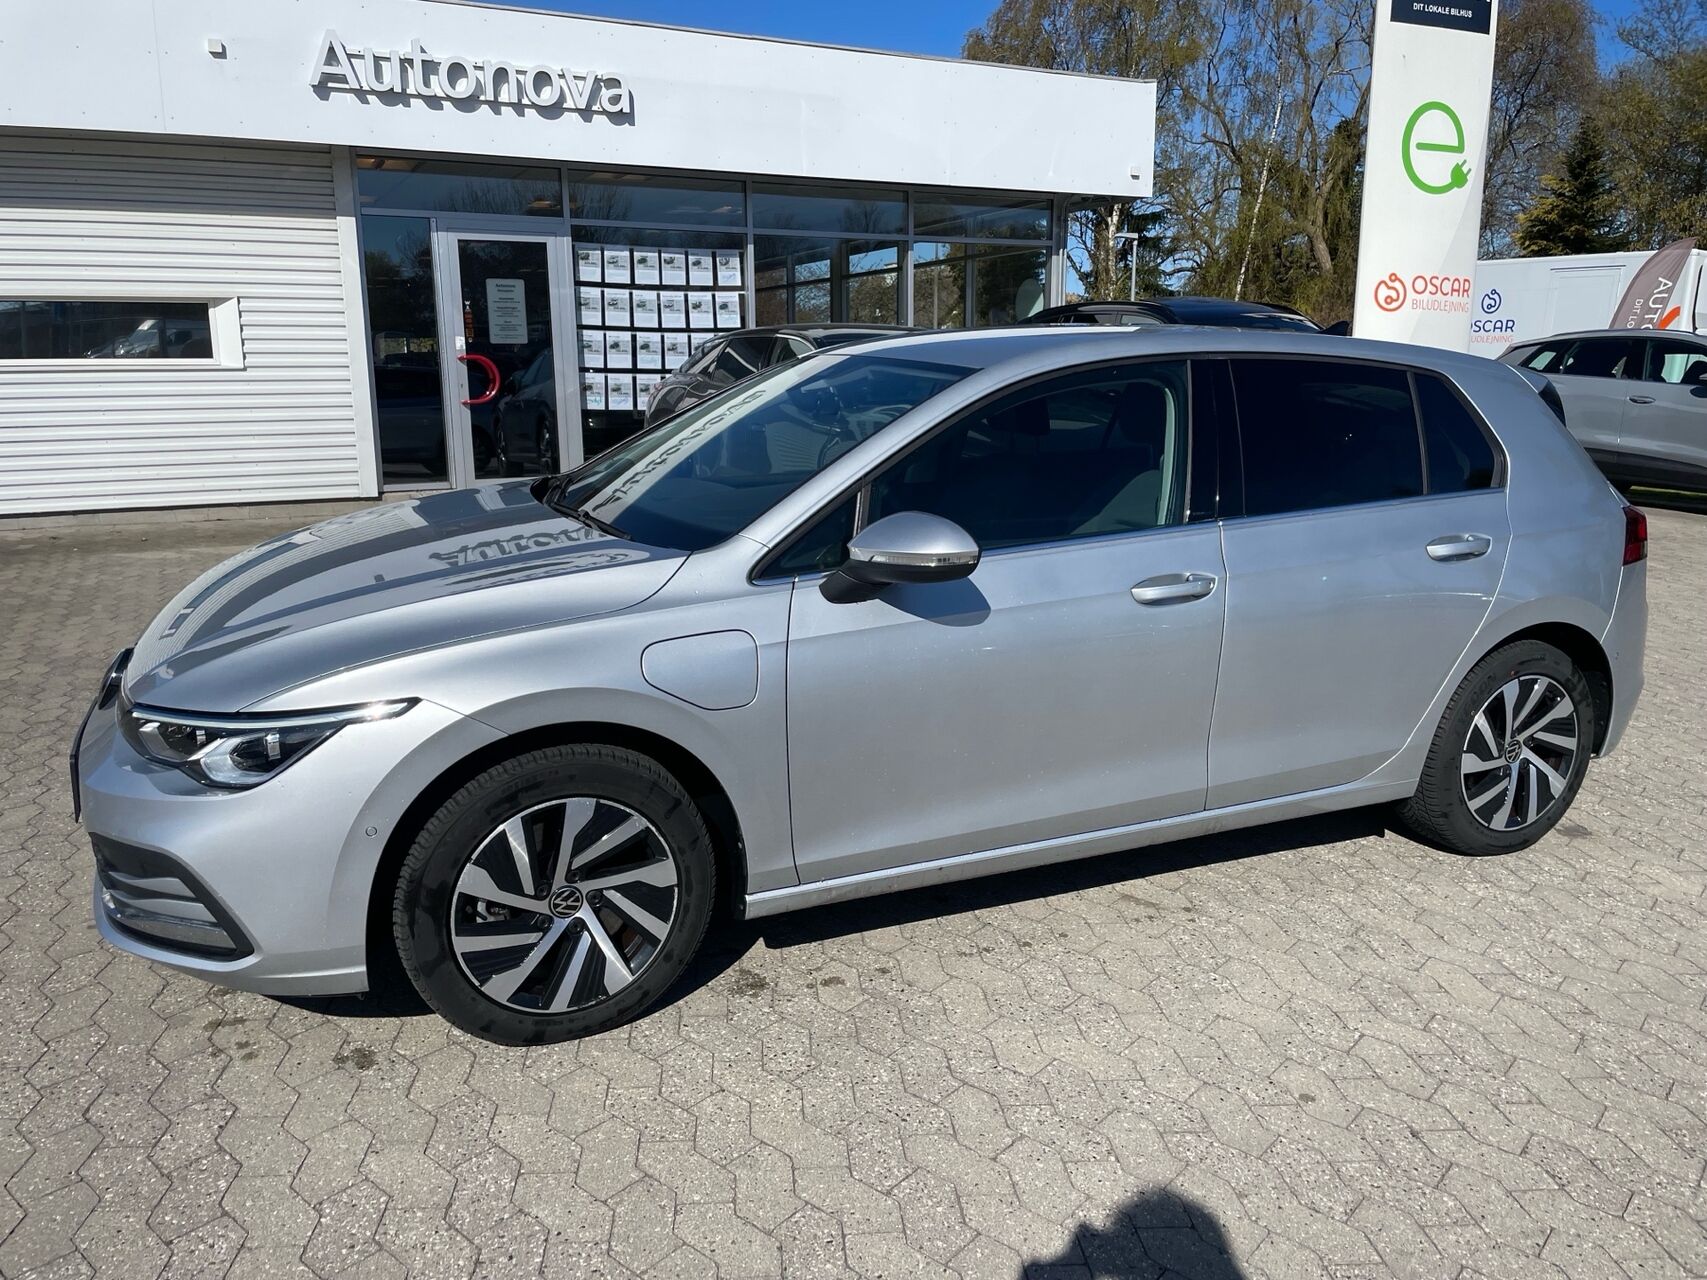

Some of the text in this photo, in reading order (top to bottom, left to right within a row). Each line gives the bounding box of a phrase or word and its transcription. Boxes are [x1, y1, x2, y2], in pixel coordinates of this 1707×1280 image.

[1413, 3, 1472, 18] DIT LOKALE BILHUS
[310, 29, 632, 114] Autonova
[1412, 275, 1471, 298] OSCAR
[1411, 298, 1470, 314] BILUDLEJNING
[1632, 299, 1644, 314] DIT
[1470, 319, 1516, 333] SCAR
[1471, 335, 1514, 345] UDLEJNING
